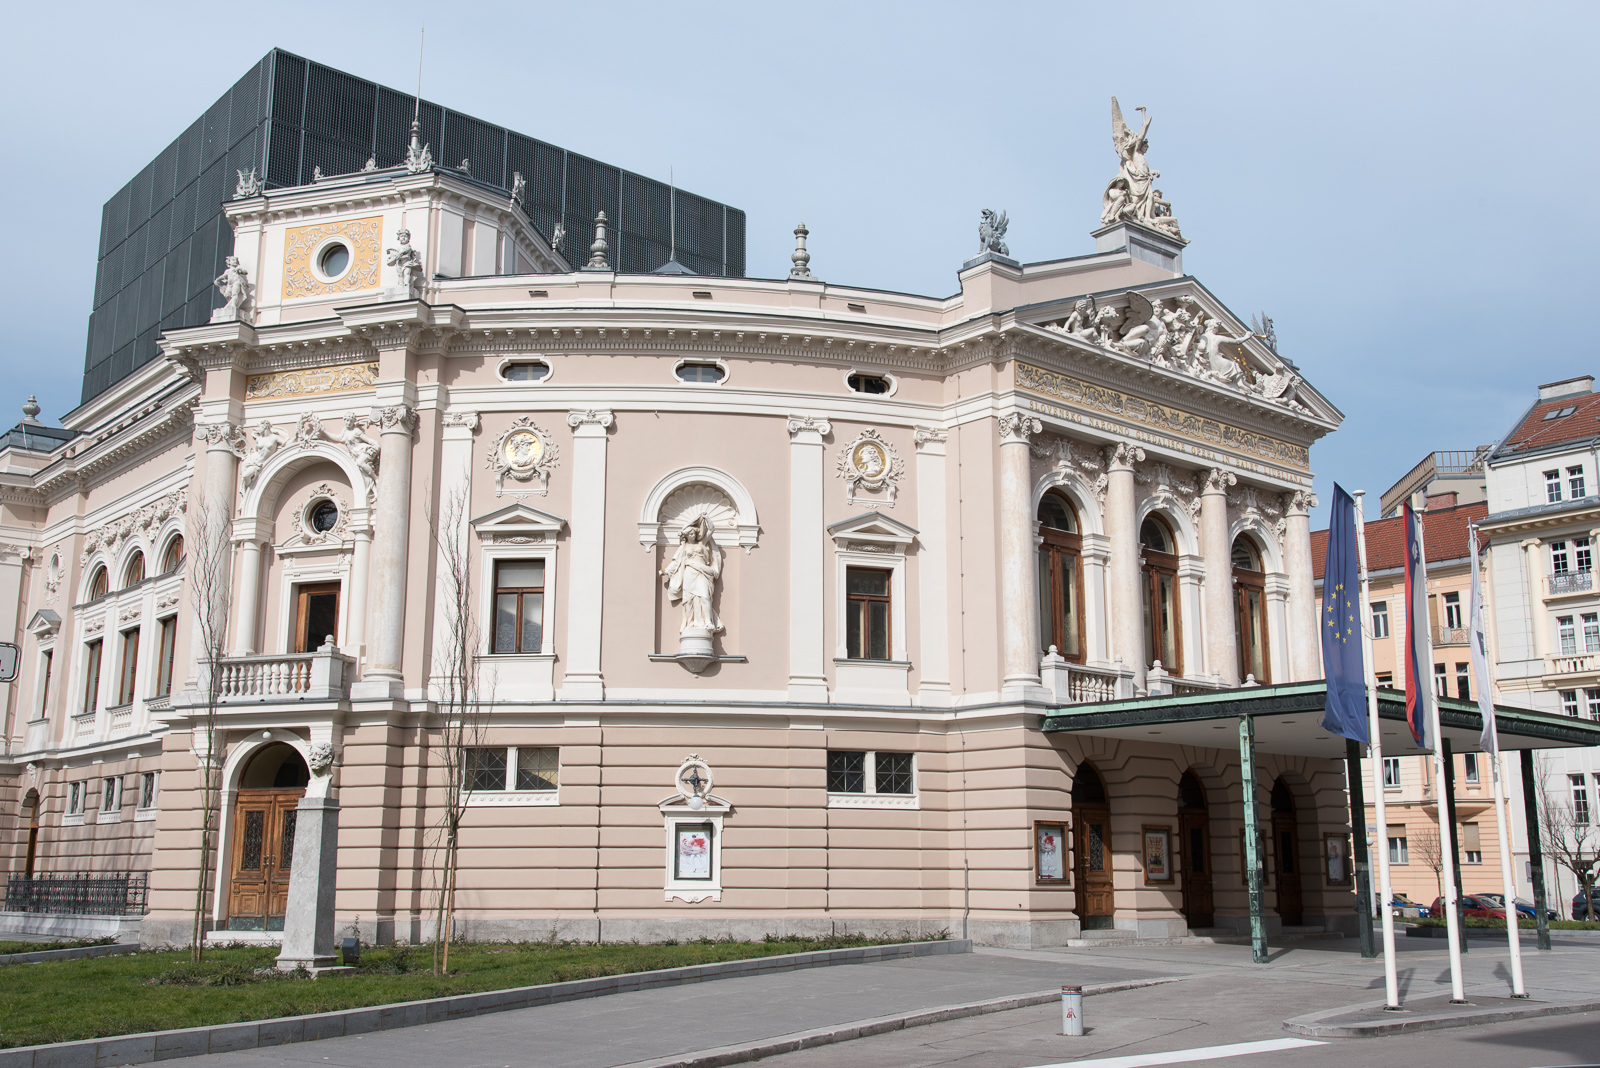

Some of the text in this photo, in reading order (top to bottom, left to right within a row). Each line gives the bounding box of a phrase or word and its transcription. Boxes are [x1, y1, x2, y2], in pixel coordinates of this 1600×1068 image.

[1029, 400, 1082, 423] SLOVENSKO
[1089, 417, 1130, 436] NARODNO
[1191, 446, 1216, 460] OPERA
[1222, 455, 1230, 464] IN
[1236, 460, 1258, 472] BALET
[1263, 466, 1303, 484] LJUBLJANA
